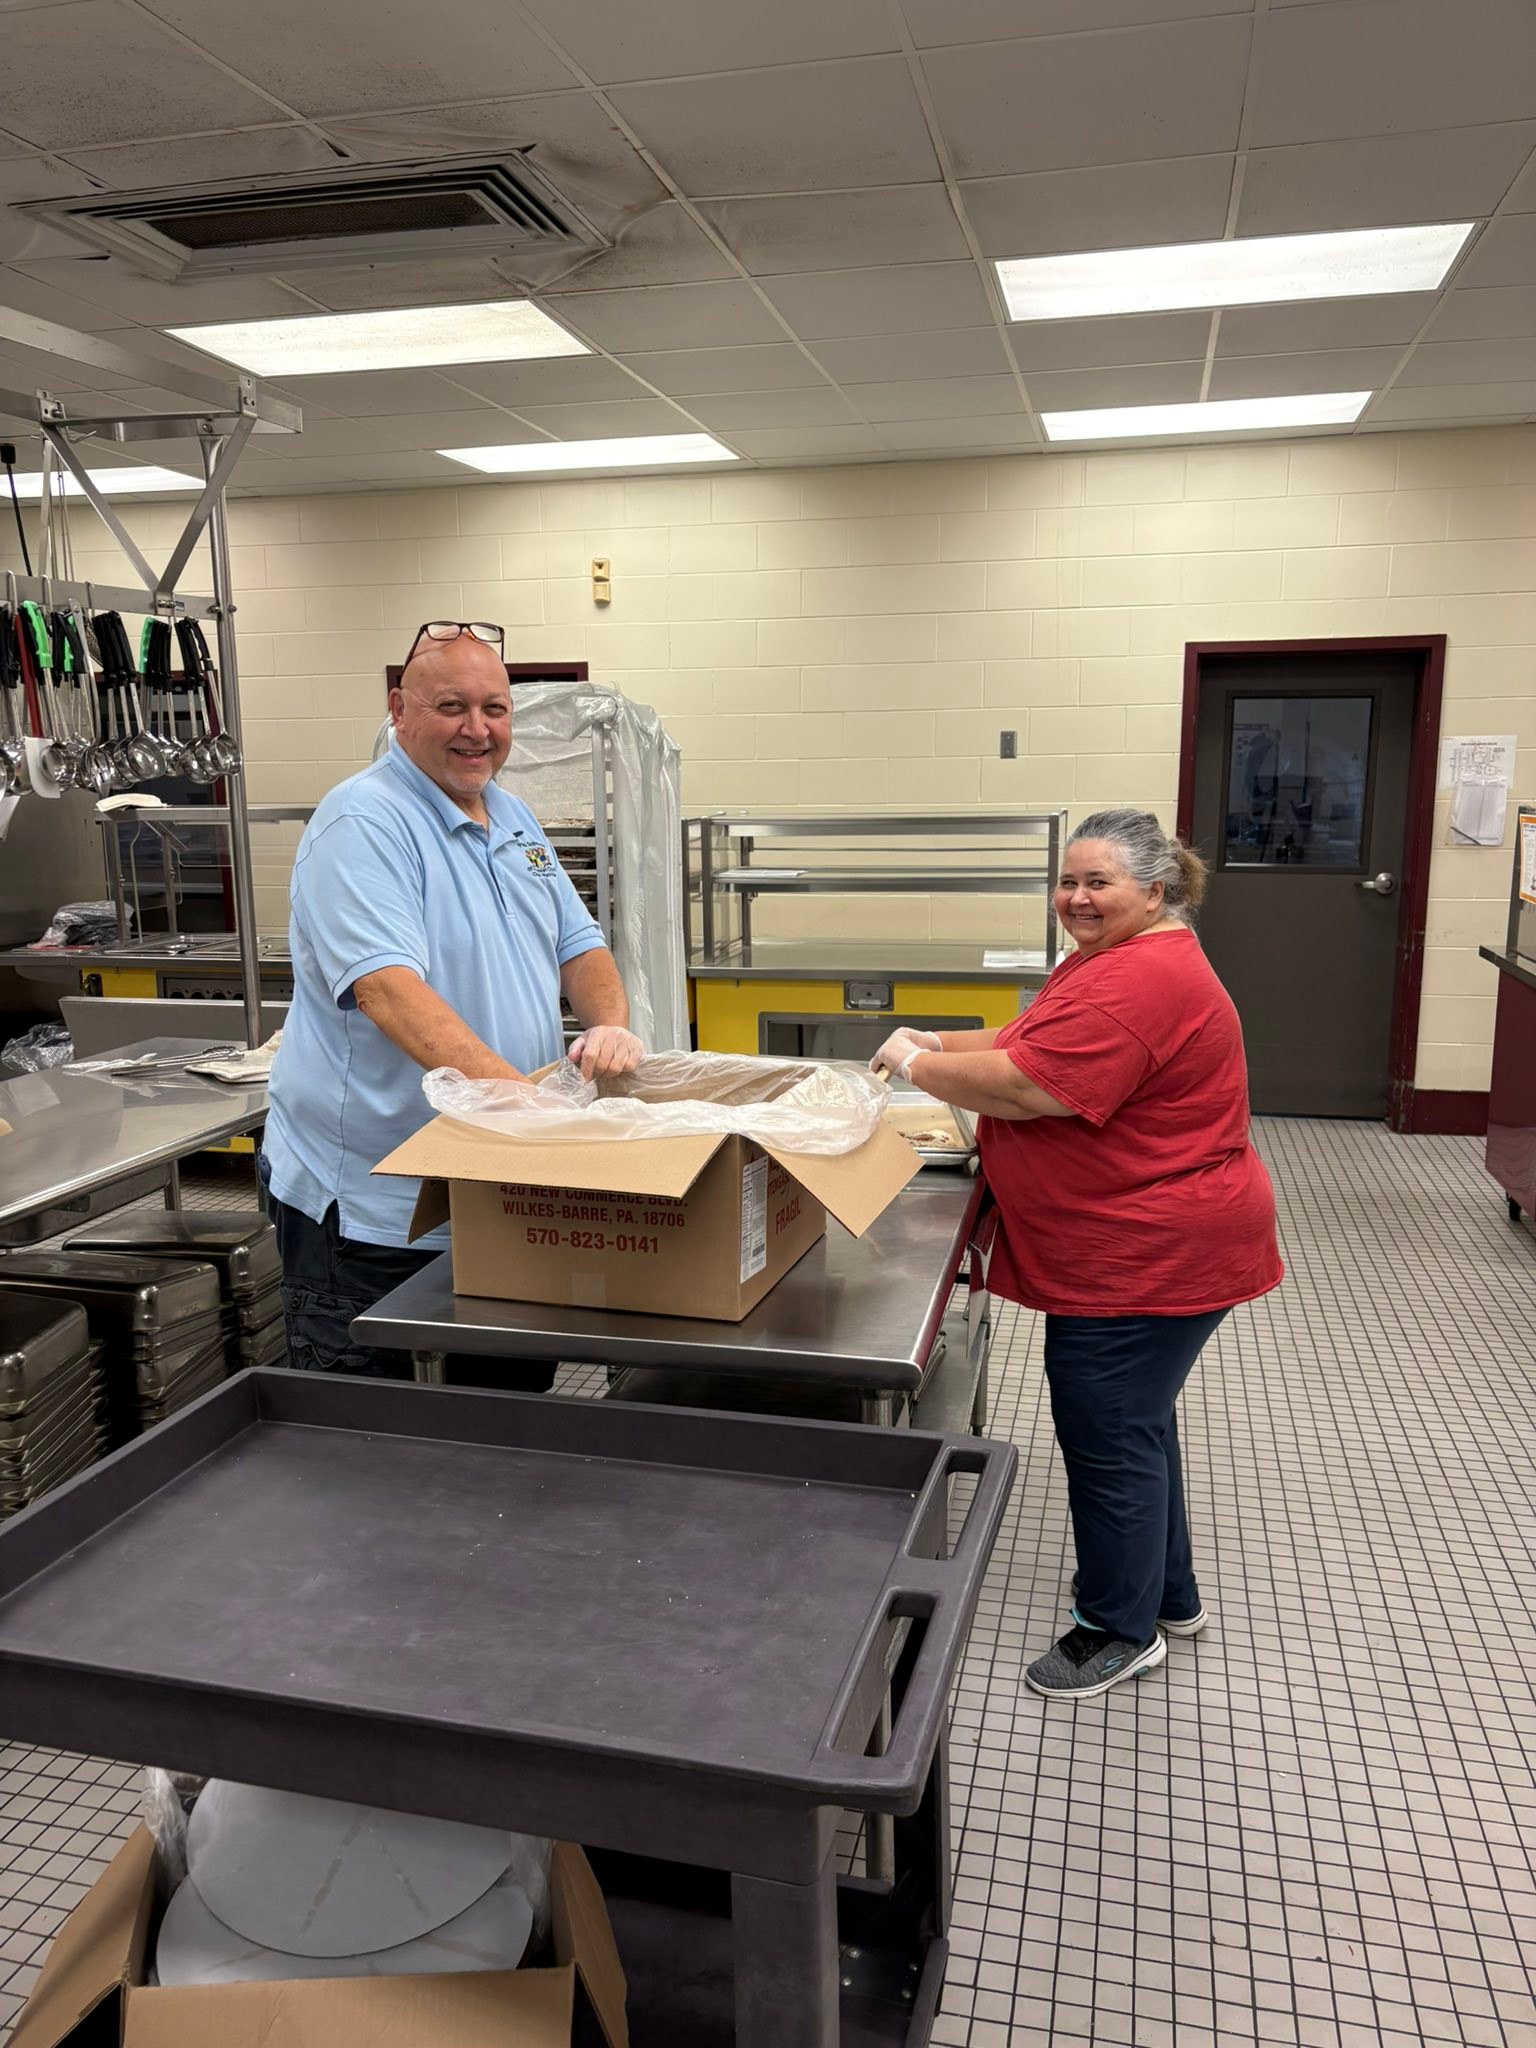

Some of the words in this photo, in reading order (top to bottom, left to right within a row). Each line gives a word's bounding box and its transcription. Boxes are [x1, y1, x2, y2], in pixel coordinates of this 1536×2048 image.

[500, 1184, 526, 1196] 420
[530, 1187, 560, 1198] NEW
[565, 1189, 643, 1205] COMMERCE
[502, 1200, 612, 1224] WILKES-BARRE,
[616, 1209, 638, 1224] PA.
[642, 1211, 685, 1228] 18706
[775, 1194, 801, 1235] FRAGIL
[527, 1227, 659, 1254] 570-823-0141
